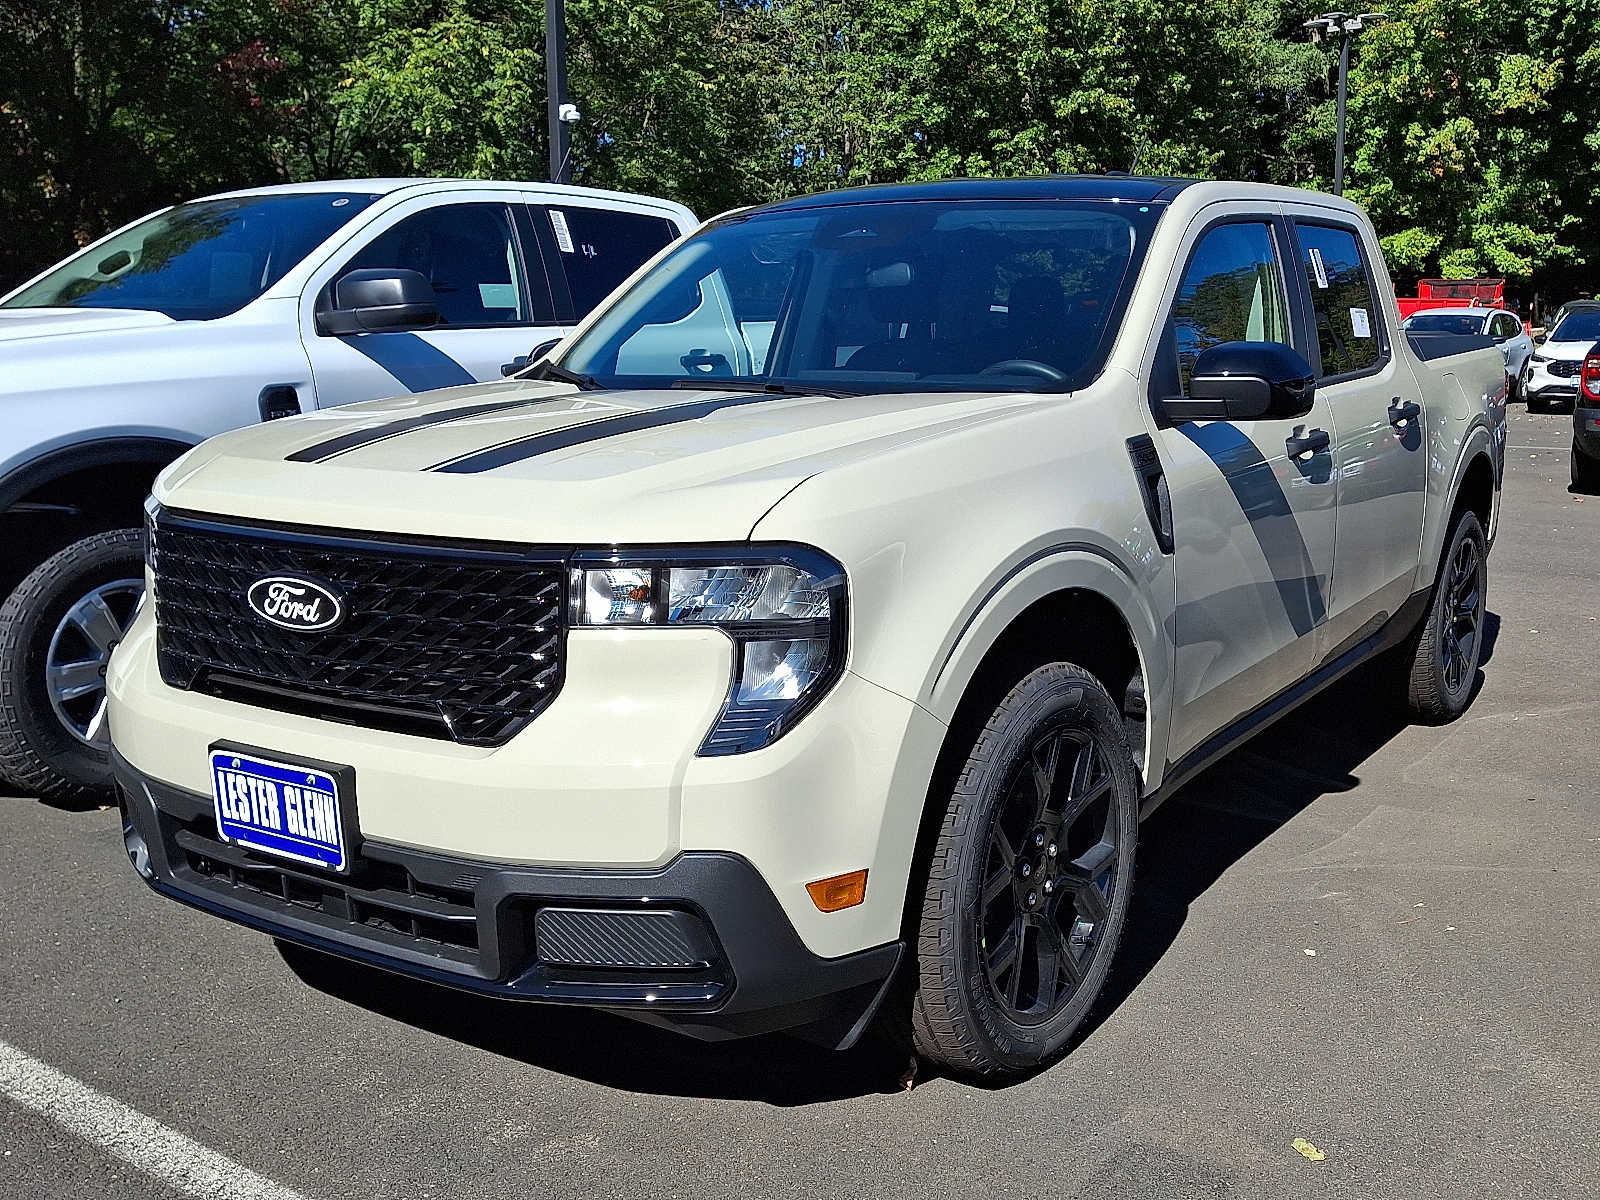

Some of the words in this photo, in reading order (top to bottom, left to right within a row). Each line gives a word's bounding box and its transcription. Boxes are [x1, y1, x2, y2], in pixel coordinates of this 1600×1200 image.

[263, 582, 320, 623] Ford
[218, 770, 281, 830] LESTER
[284, 784, 338, 845] GLENN
